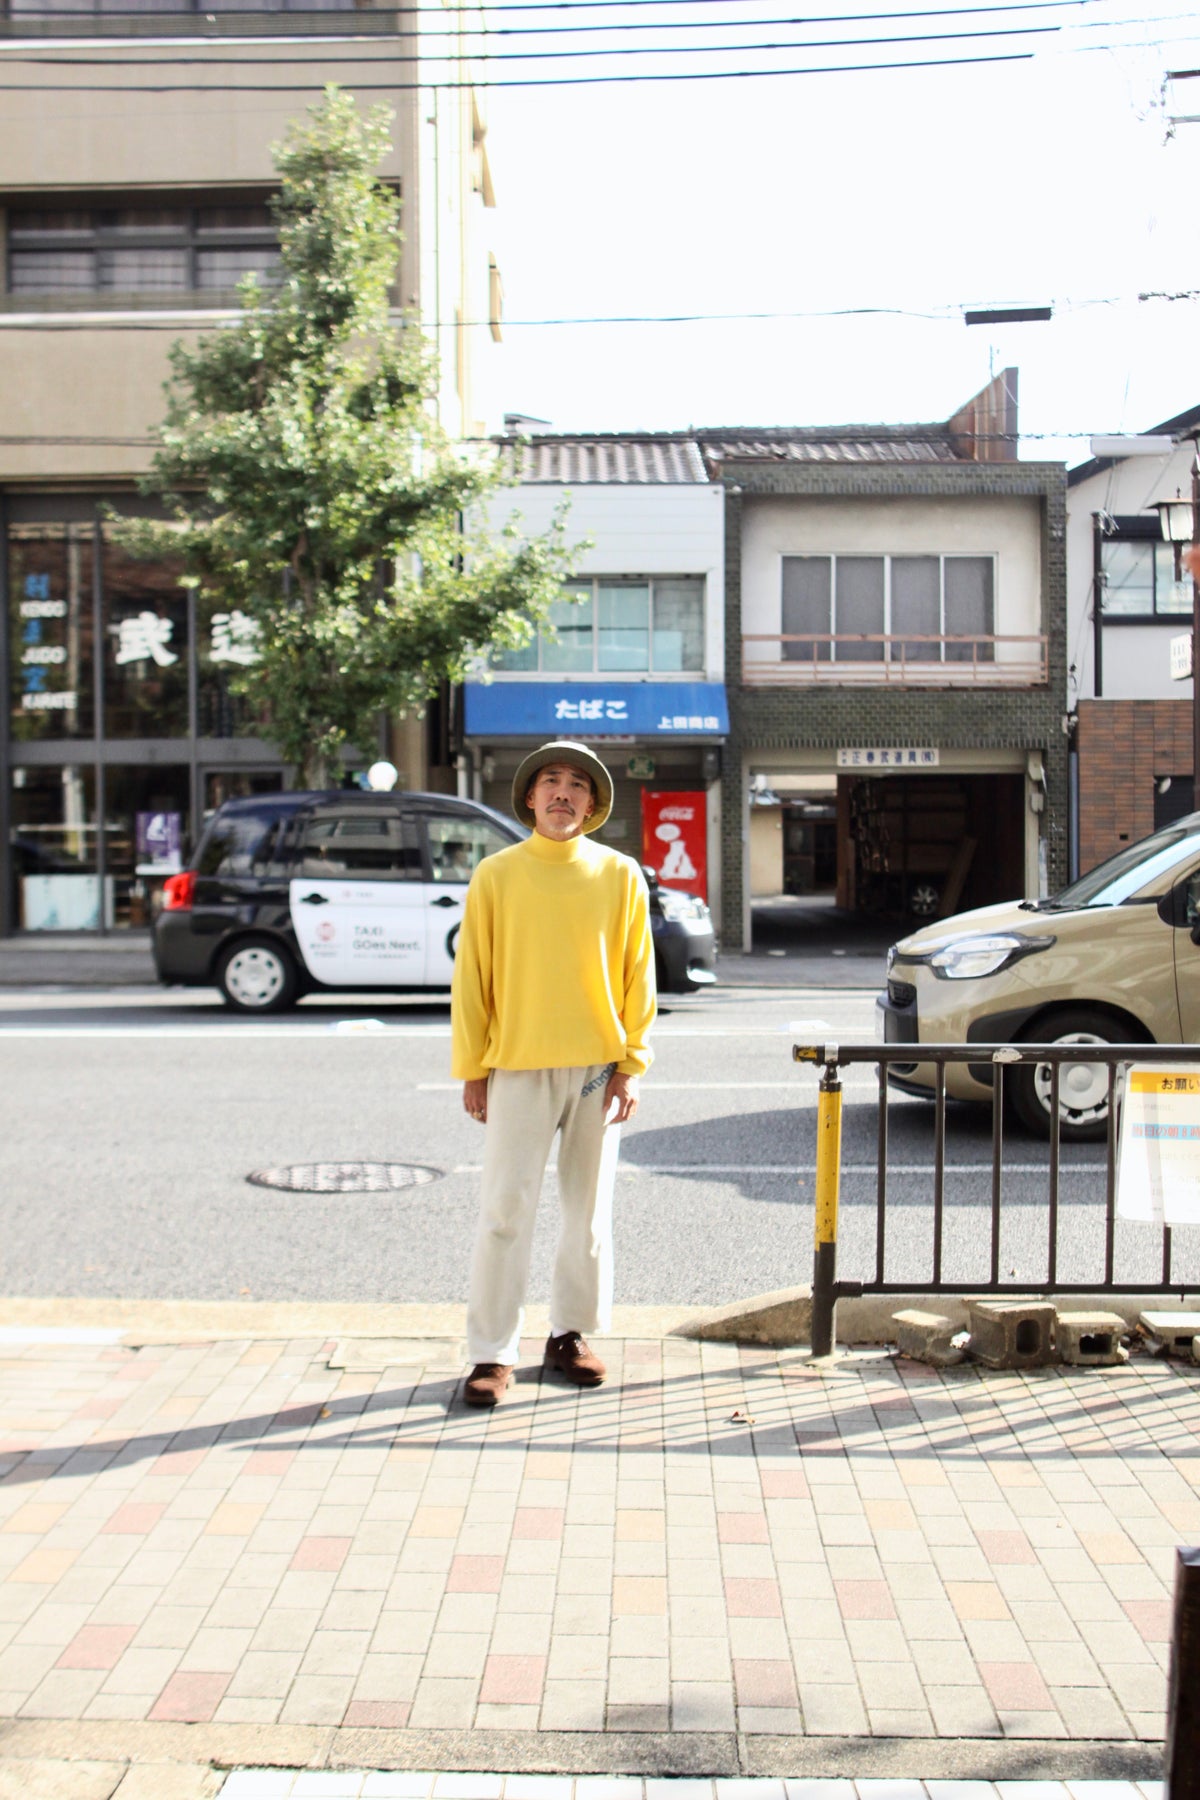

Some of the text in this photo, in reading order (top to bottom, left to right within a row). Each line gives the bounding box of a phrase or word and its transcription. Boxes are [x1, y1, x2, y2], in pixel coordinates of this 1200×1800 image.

[20, 646, 67, 664] JUDO
[21, 692, 78, 710] KARATE
[555, 699, 628, 719] たばこ
[657, 716, 720, 730] 上田商店
[354, 925, 383, 936] TAXI
